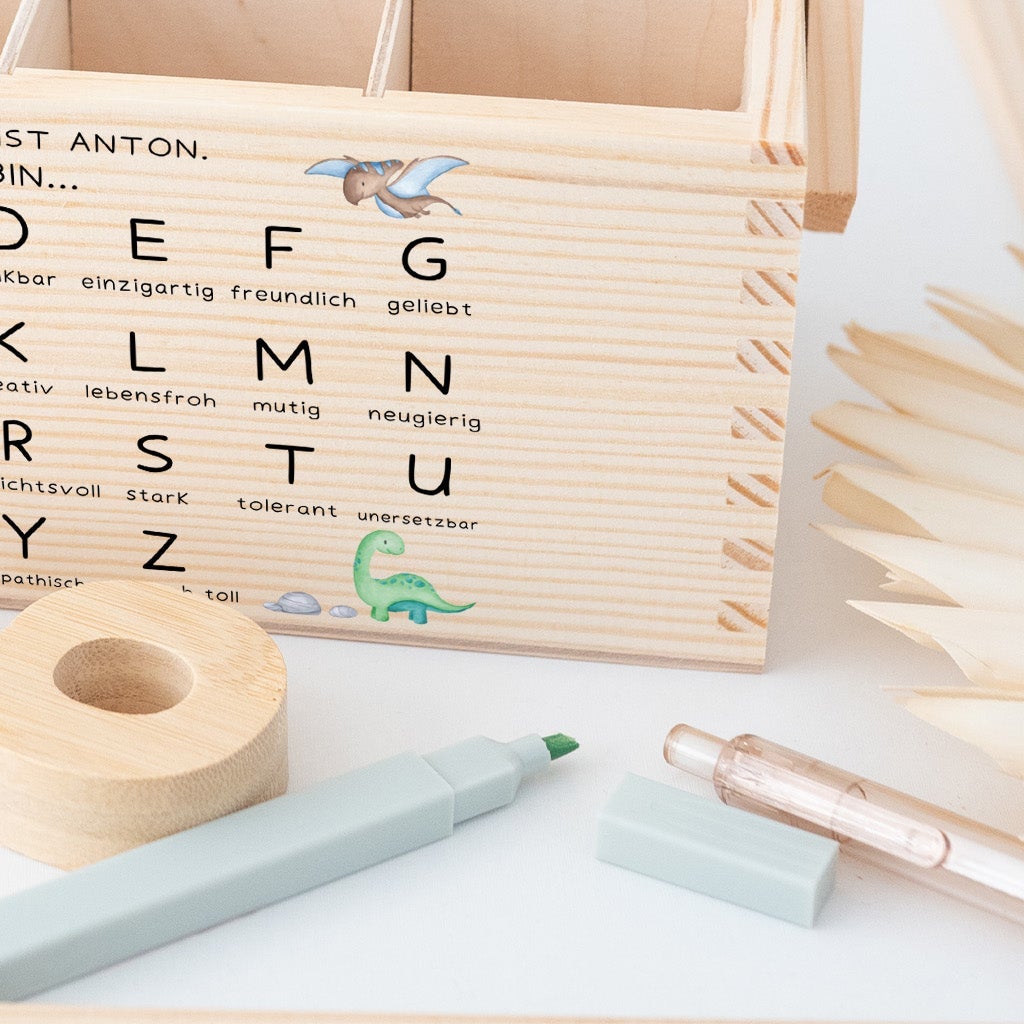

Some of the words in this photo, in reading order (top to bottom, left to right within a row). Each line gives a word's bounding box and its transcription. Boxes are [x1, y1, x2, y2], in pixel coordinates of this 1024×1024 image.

[69, 131, 208, 161] ANTON.
[129, 217, 168, 262] E
[264, 225, 303, 270] F
[401, 236, 447, 281] G
[81, 275, 214, 302] einzigartig
[230, 284, 356, 308] freundlich
[387, 298, 472, 317] geliebt
[129, 331, 166, 373] L
[255, 337, 314, 385] M
[405, 350, 452, 396] N
[85, 384, 216, 408] lebensfroh
[253, 401, 320, 420] mutig
[368, 409, 481, 433] neugierig
[2, 419, 33, 462] R
[136, 434, 174, 473] S
[264, 443, 315, 485] T
[237, 497, 337, 518] tolerant
[358, 512, 478, 530] unersetzbar
[1, 513, 47, 560] Y
[142, 529, 186, 573] Z
[204, 589, 239, 604] toll
